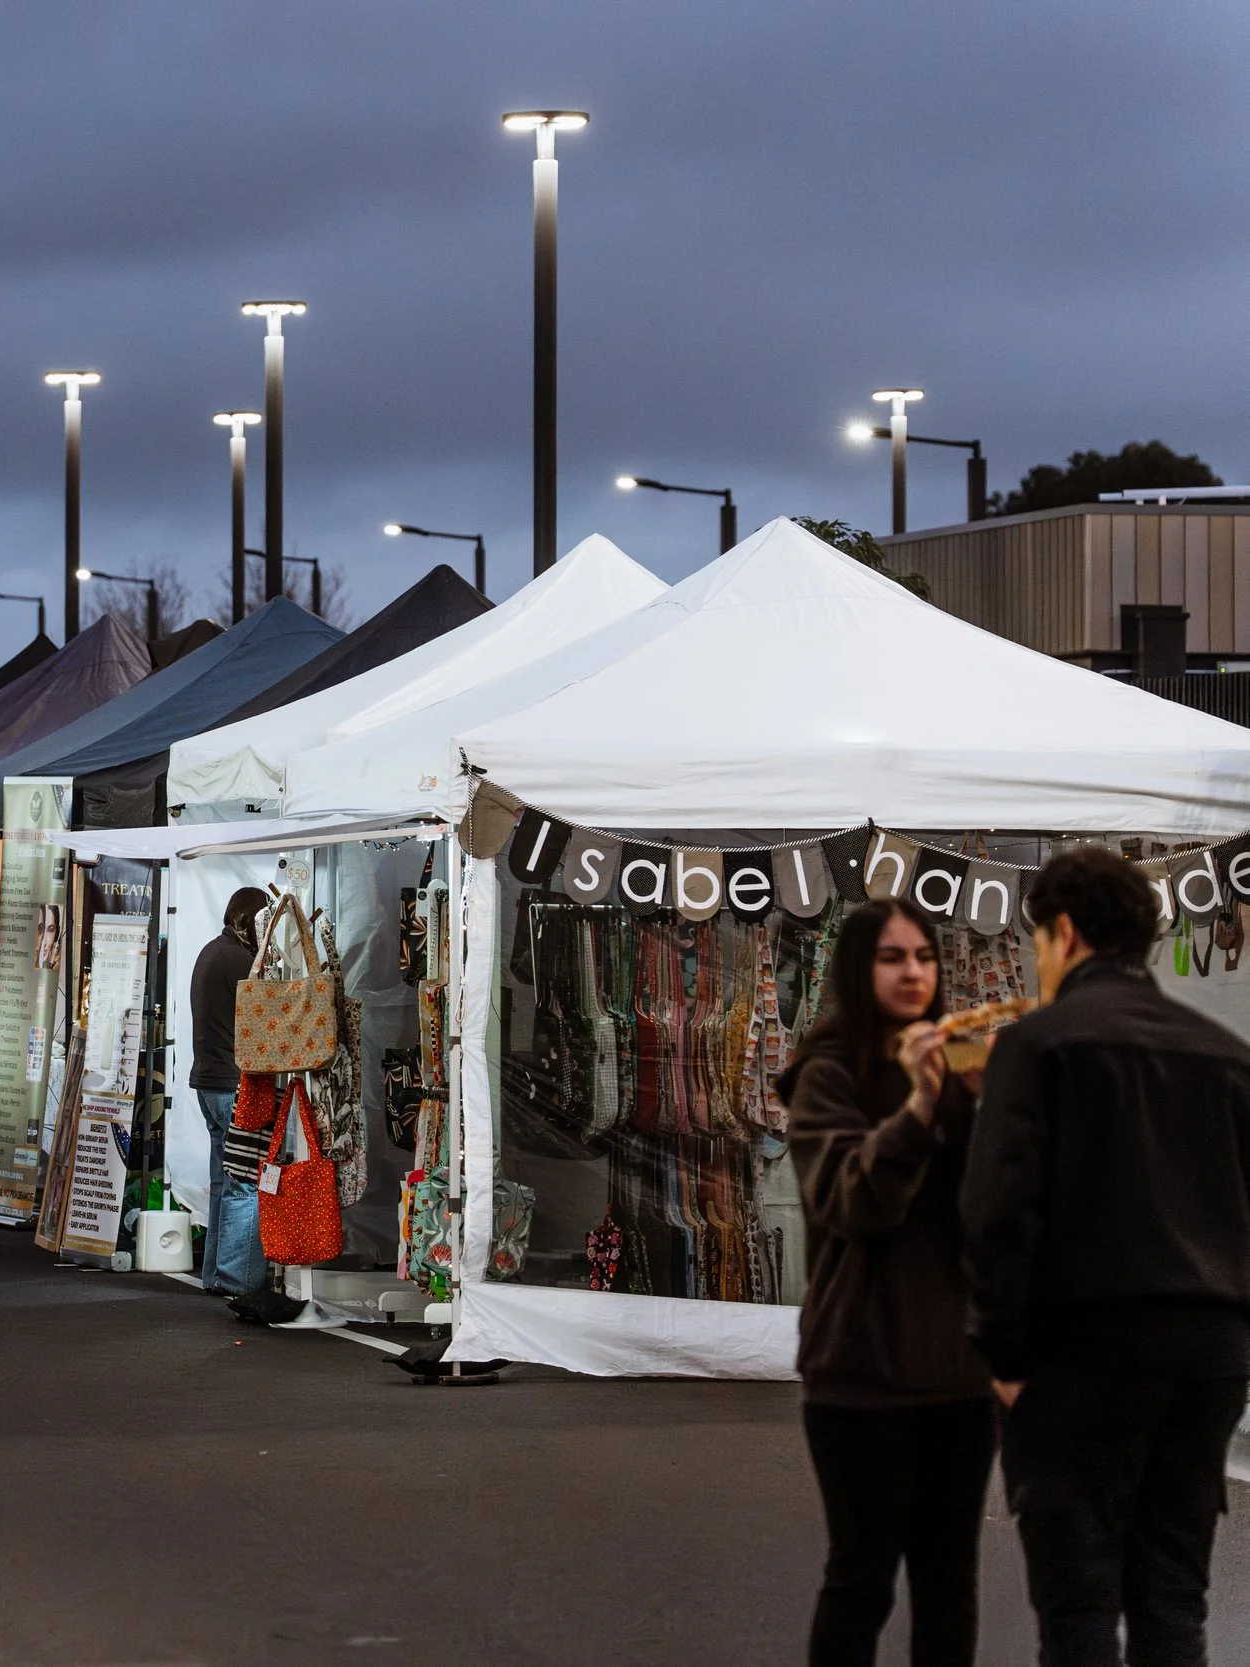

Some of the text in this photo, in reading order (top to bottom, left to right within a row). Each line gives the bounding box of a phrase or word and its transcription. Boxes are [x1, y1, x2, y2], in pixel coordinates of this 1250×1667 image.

[526, 820, 812, 911] Isabel
[288, 867, 307, 880] $50
[76, 1154, 106, 1165] TREATS DANDRUFF
[74, 1177, 89, 1185] REDUCES
[73, 1188, 84, 1197] STOPS
[94, 1191, 103, 1199] FROM
[72, 1199, 87, 1208] EXTENDS
[93, 1202, 107, 1211] GROWTH
[107, 1204, 120, 1213] PHASE
[86, 1212, 98, 1220] SERUM
[79, 1222, 99, 1232] APPLICATION
